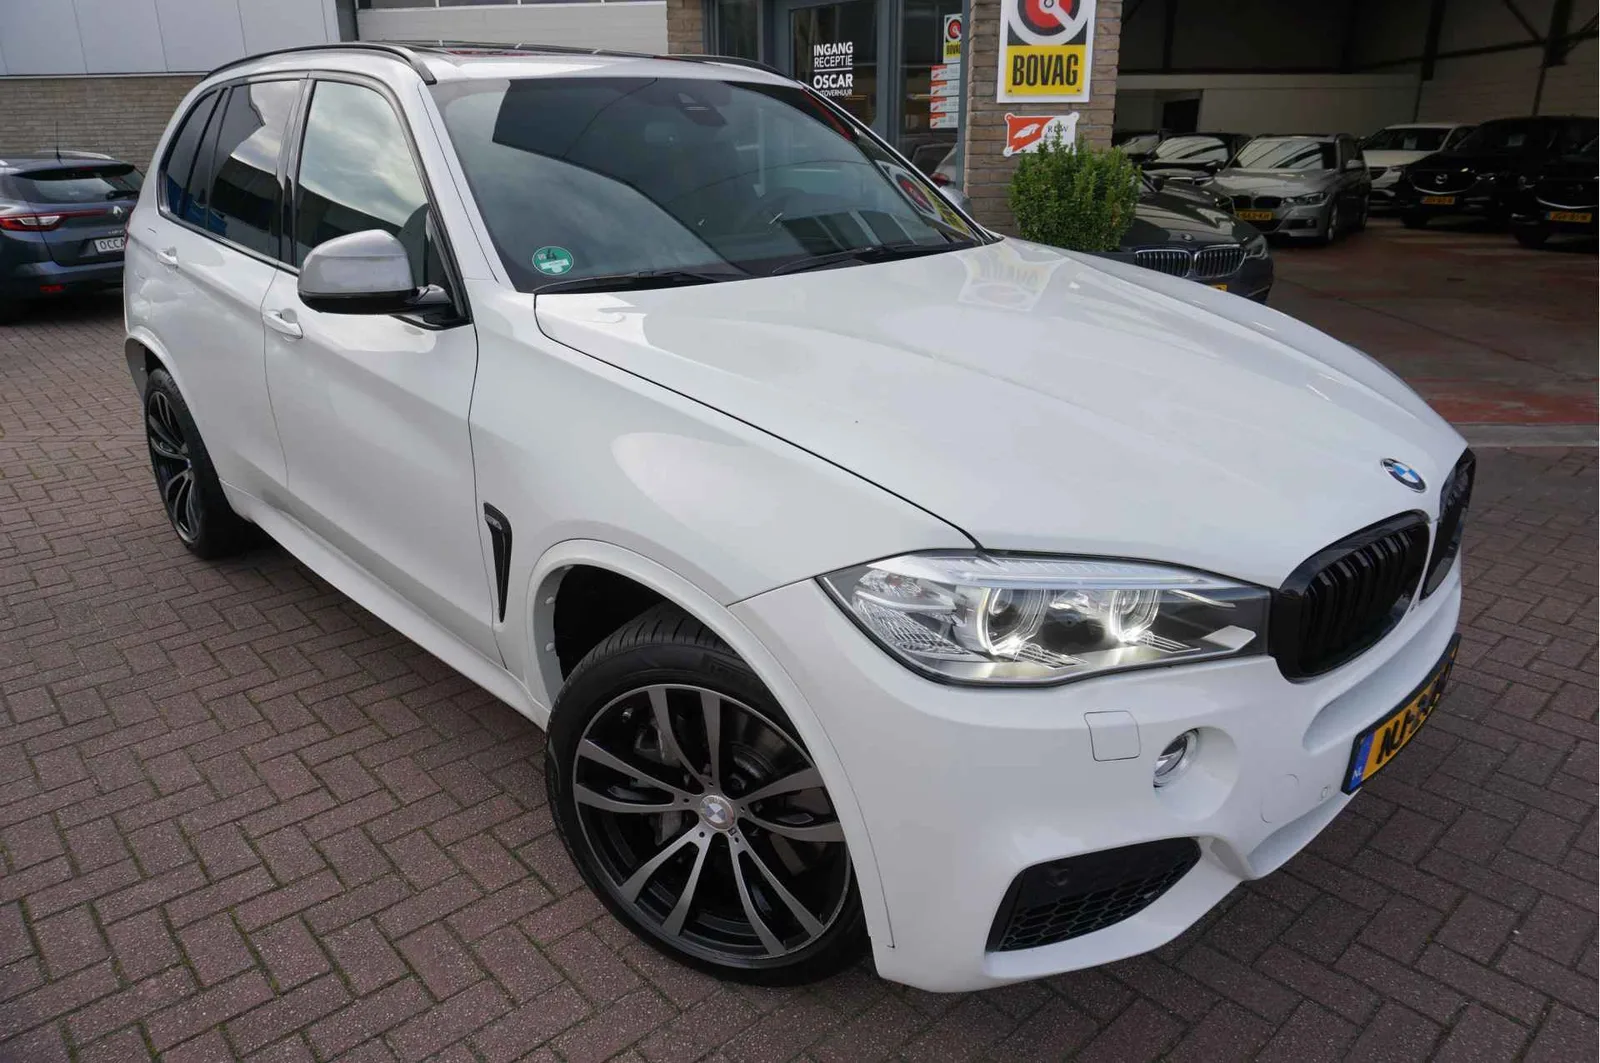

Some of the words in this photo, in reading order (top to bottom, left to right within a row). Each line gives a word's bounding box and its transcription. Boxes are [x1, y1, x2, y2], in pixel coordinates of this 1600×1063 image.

[813, 41, 854, 57] INGANG
[814, 54, 853, 68] RECEPTIE
[1012, 53, 1079, 86] BOVAG
[813, 73, 854, 89] OSCAR
